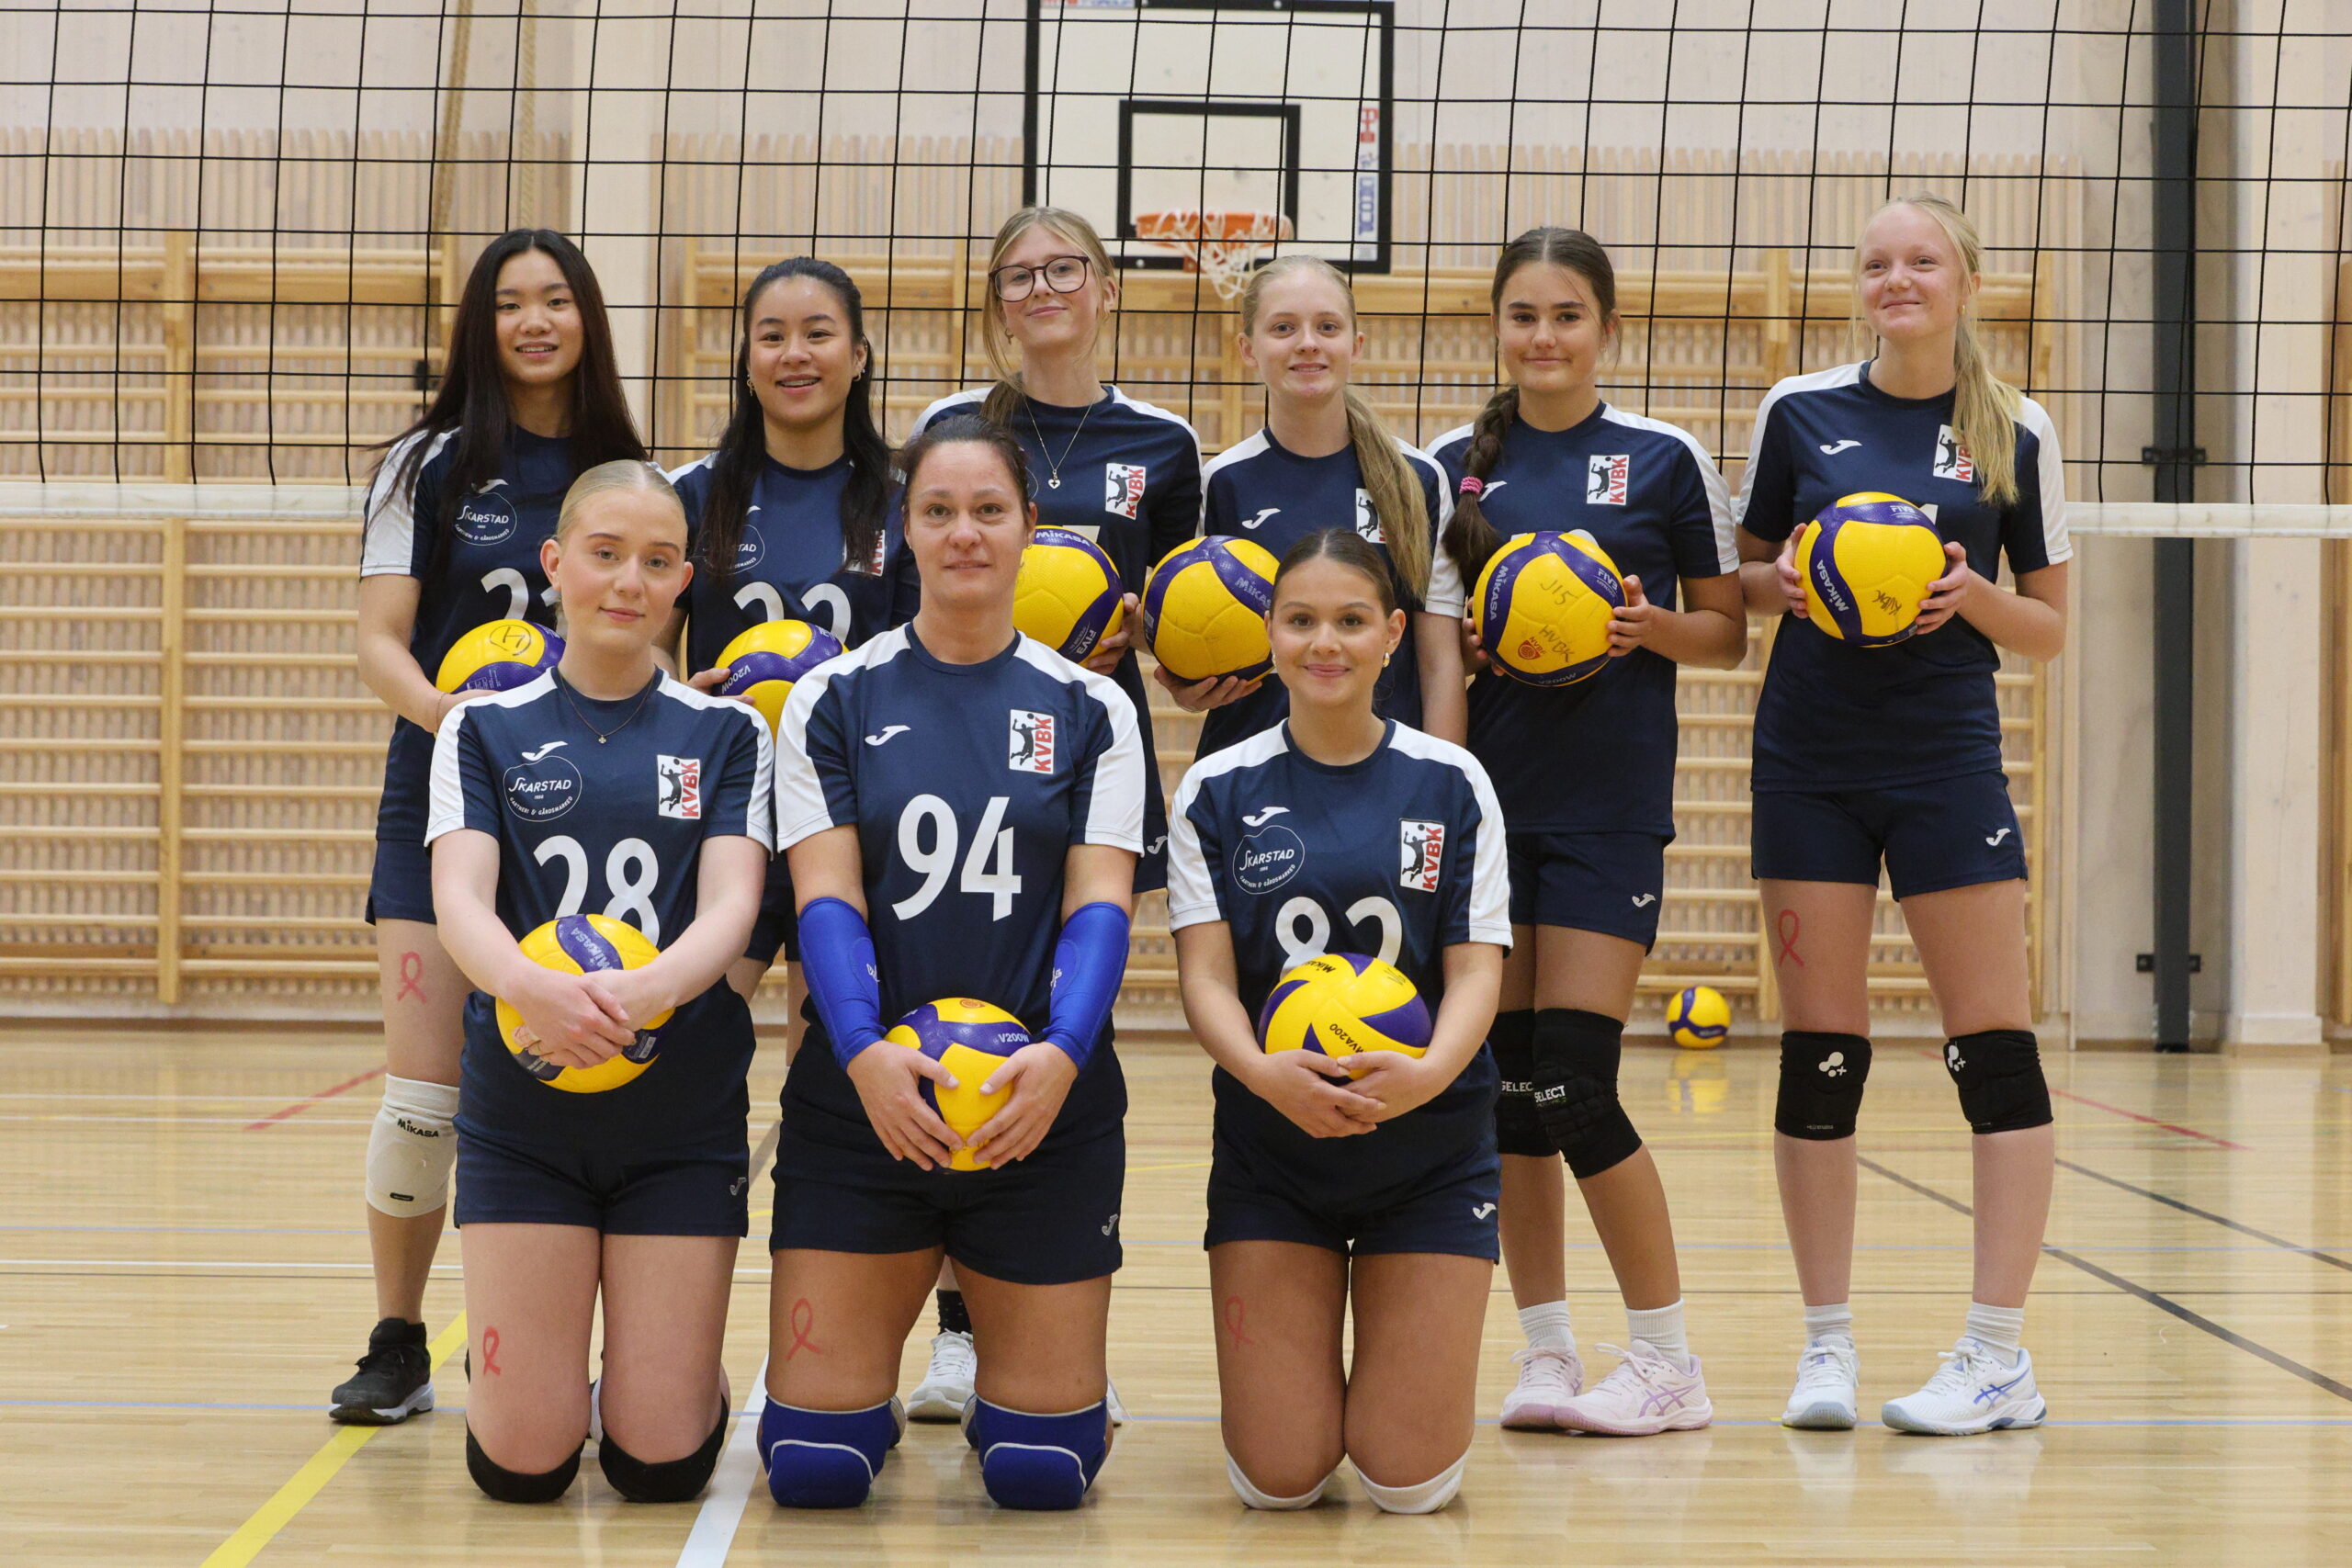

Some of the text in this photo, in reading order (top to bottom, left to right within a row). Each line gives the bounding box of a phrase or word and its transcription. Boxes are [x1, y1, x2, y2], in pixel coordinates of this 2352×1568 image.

[1955, 445, 1972, 480] KVB
[1125, 468, 1144, 518] KVBK
[1609, 457, 1627, 503] KVBK
[457, 505, 509, 524] SKARSTAD
[1597, 568, 1618, 591] FIVB
[1076, 628, 1097, 655] FIVB
[721, 664, 752, 694] V200W
[1033, 716, 1052, 773] KVBK
[508, 776, 572, 793] SKARSTAD
[681, 761, 699, 818] KVBK
[891, 794, 1022, 922] 94
[1239, 850, 1295, 871] SKARSTAD
[1422, 827, 1442, 891] KVBK
[533, 835, 660, 947] 28
[1501, 1080, 1534, 1092] SELEC
[1534, 1085, 1566, 1102] SELECT
